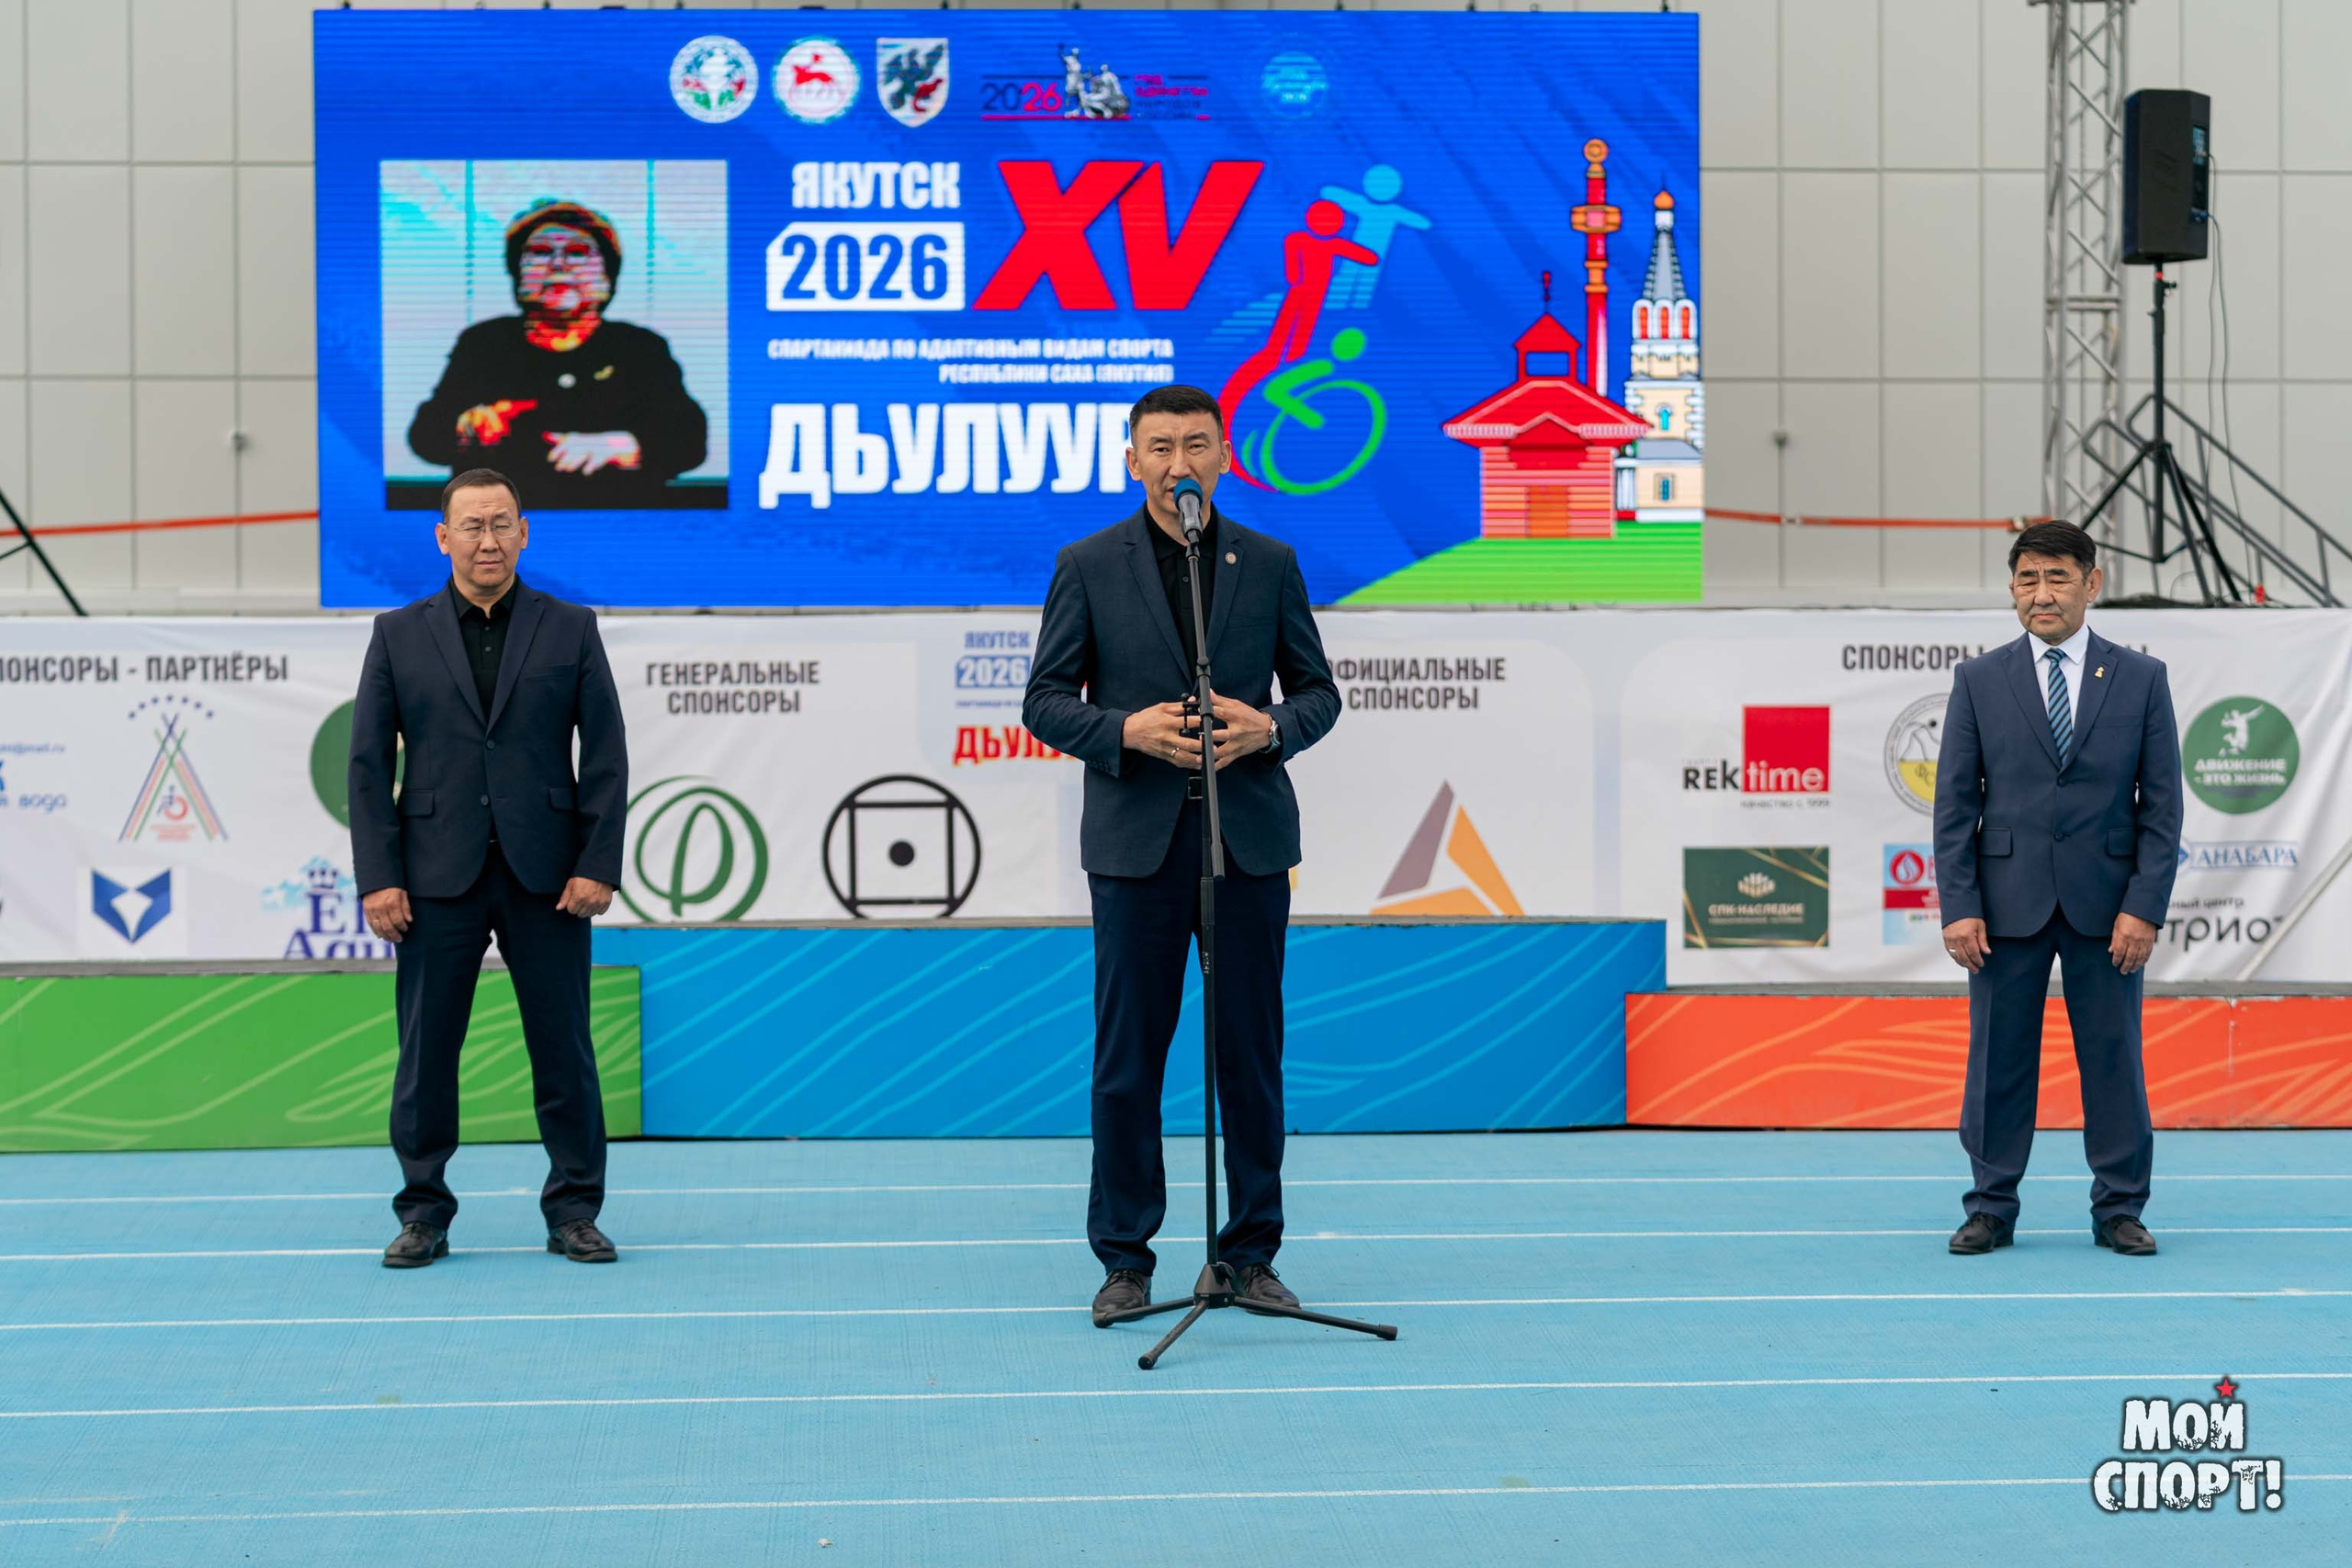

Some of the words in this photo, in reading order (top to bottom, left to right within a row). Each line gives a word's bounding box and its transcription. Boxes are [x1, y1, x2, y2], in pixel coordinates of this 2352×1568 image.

[982, 82, 1062, 112] 2026
[792, 162, 960, 209] ЯКУТСК
[973, 161, 1264, 310] XV
[781, 233, 948, 300] 2026
[891, 338, 917, 359] ПО
[1043, 338, 1105, 359] ВИДАМ
[1107, 338, 1174, 358] СПОРТА
[965, 631, 1030, 648] ЯКУТСК
[146, 651, 288, 681] ПАРТНЁРЫ
[646, 660, 820, 686] ГЕНЕРАЛЬНЫЕ
[958, 657, 1024, 686] 2026
[1329, 658, 1506, 683] ФИЦИАЛЬНЫЕ
[667, 690, 800, 715] СПОНСОРЫ
[1349, 687, 1479, 709] СПОНСОРЫ
[2195, 759, 2286, 771] ДВИЖЕНИЕ
[2203, 773, 2232, 785] ЭТО
[2234, 773, 2286, 785] ЖИЗНЬ
[2197, 847, 2298, 865] АНАБАРА
